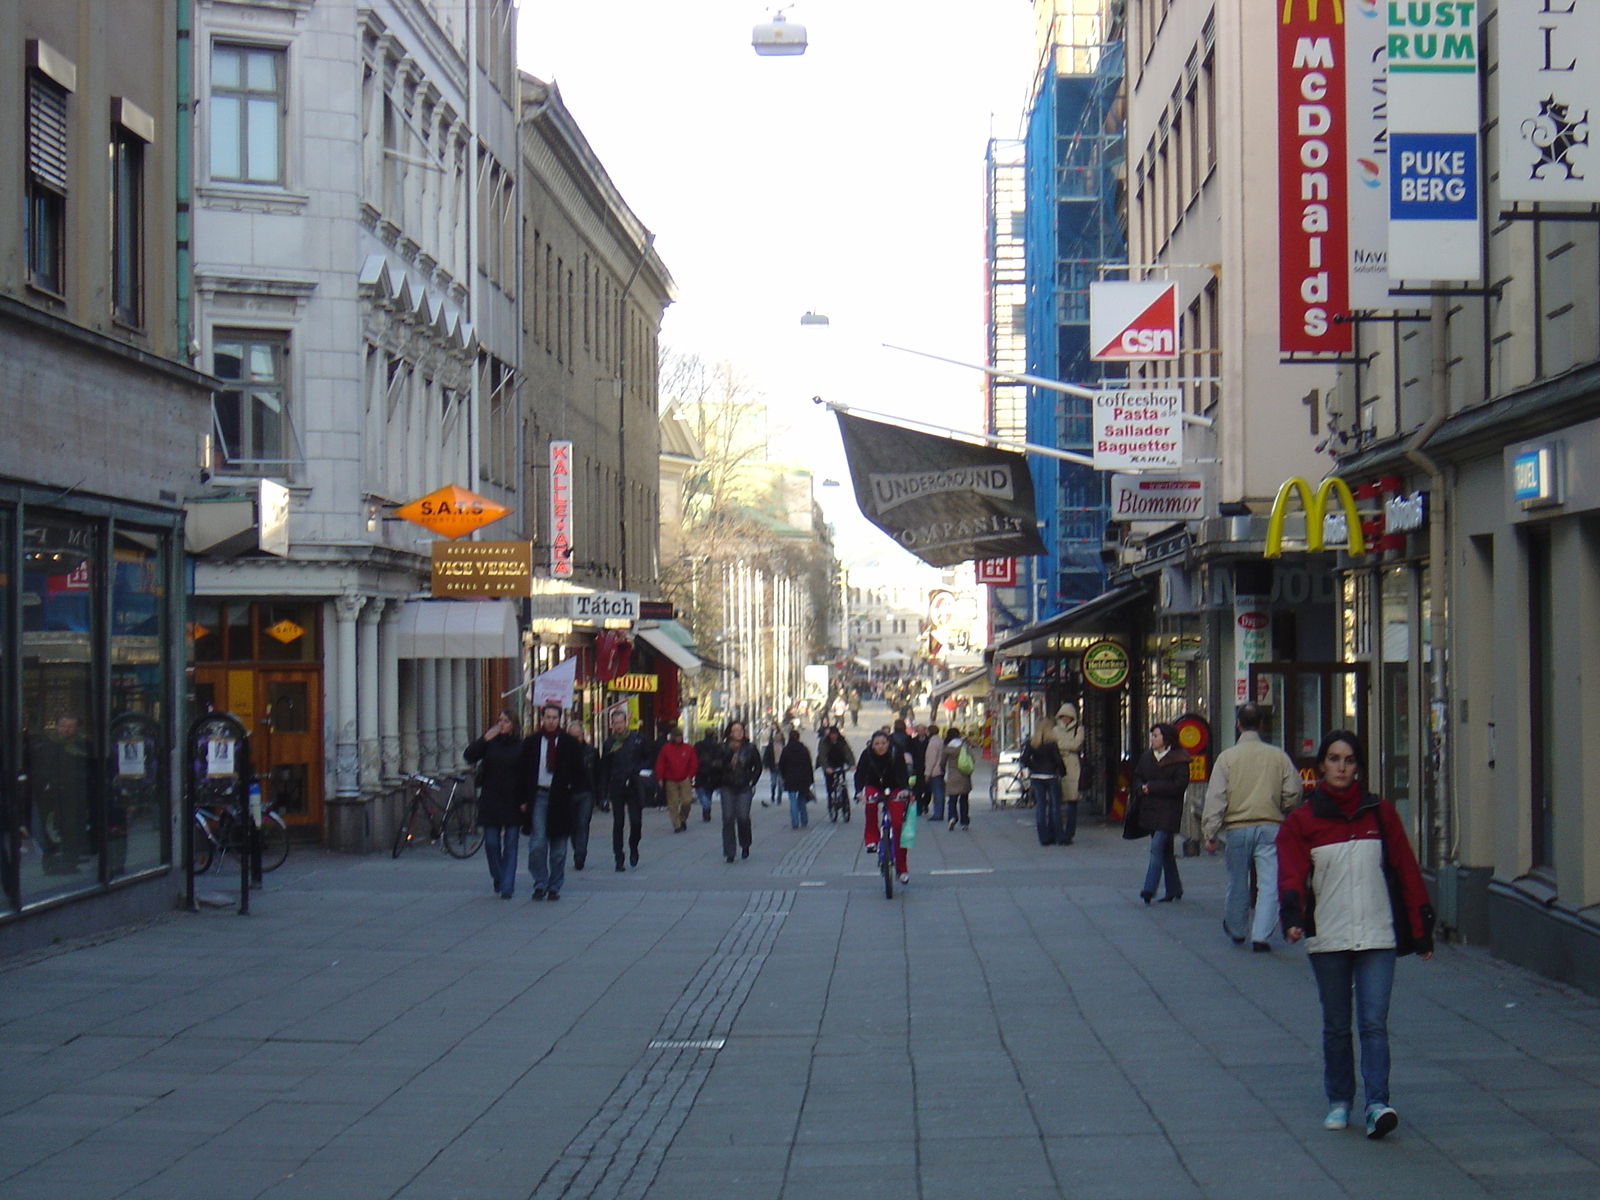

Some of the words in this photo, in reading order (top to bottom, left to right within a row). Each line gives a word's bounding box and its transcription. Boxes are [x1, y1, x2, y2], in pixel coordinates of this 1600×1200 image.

[1388, 2, 1475, 27] LUST
[1388, 34, 1475, 59] RUM
[1401, 151, 1466, 175] PUKE
[1401, 178, 1466, 202] BERG
[1122, 329, 1173, 353] csn
[1097, 392, 1177, 410] Coffeeshop
[1302, 389, 1319, 435] 1
[1113, 408, 1158, 420] Pasta
[1105, 425, 1170, 437] Sallader
[1098, 441, 1177, 455] Baguetter
[1118, 488, 1201, 514] Blommor
[434, 561, 473, 575] VICE
[475, 561, 529, 575] VERSA
[613, 676, 653, 690] GODIS
